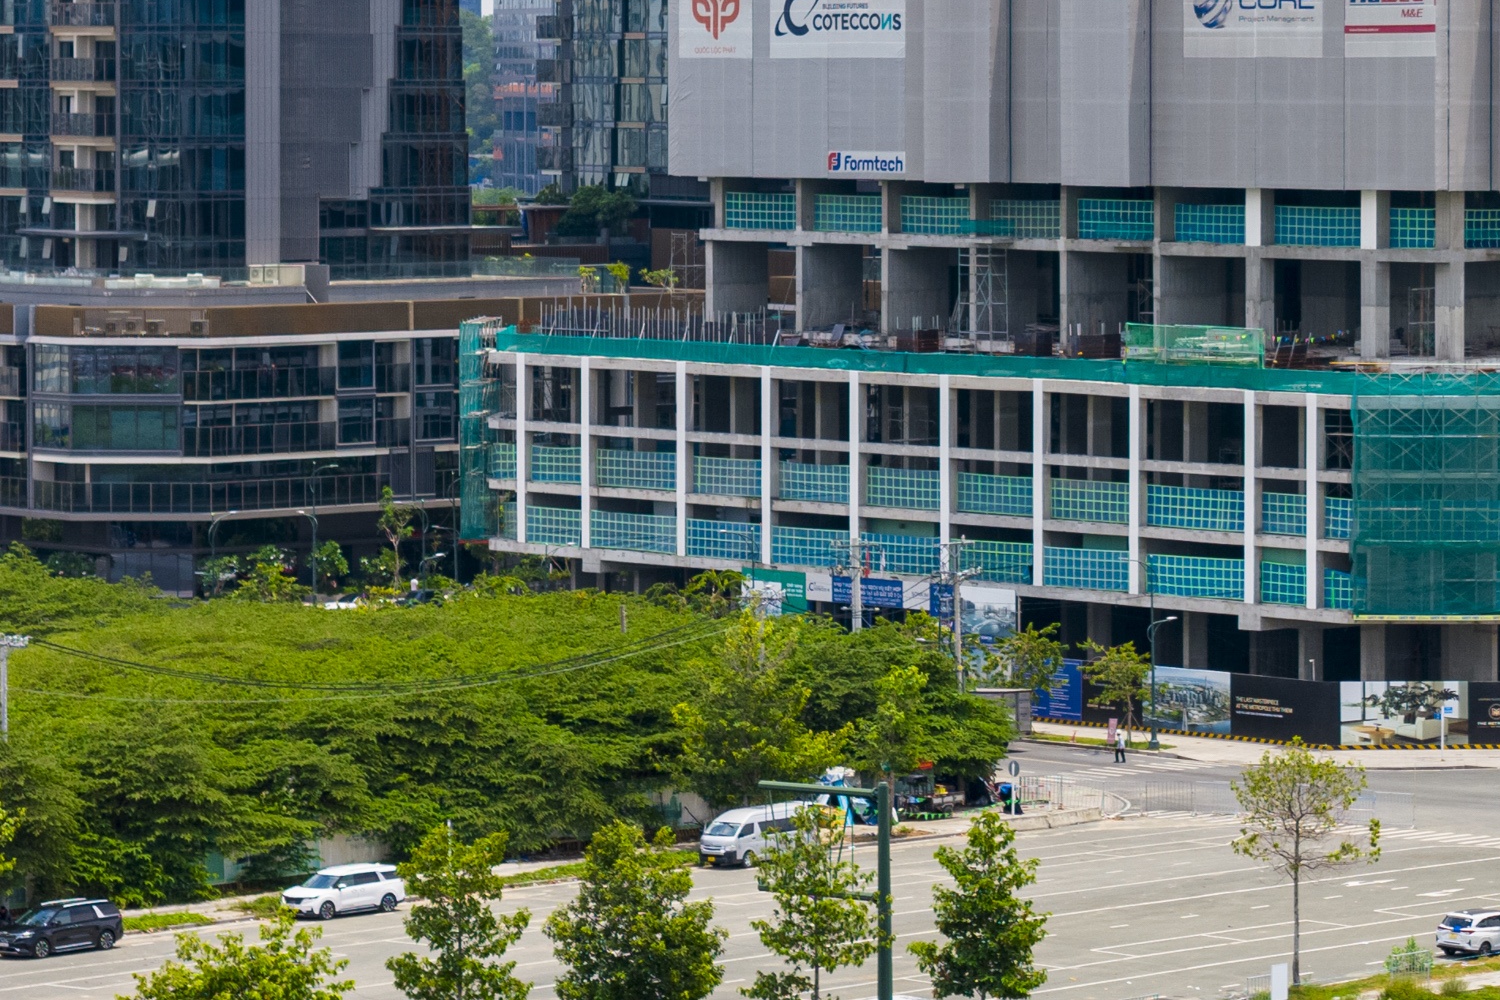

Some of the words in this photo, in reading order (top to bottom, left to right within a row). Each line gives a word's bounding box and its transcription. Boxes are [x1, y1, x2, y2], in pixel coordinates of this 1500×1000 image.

[1267, 15, 1314, 23] Management
[1401, 8, 1424, 18] M&E
[813, 13, 902, 31] COTECCONS
[844, 155, 903, 172] Formtech
